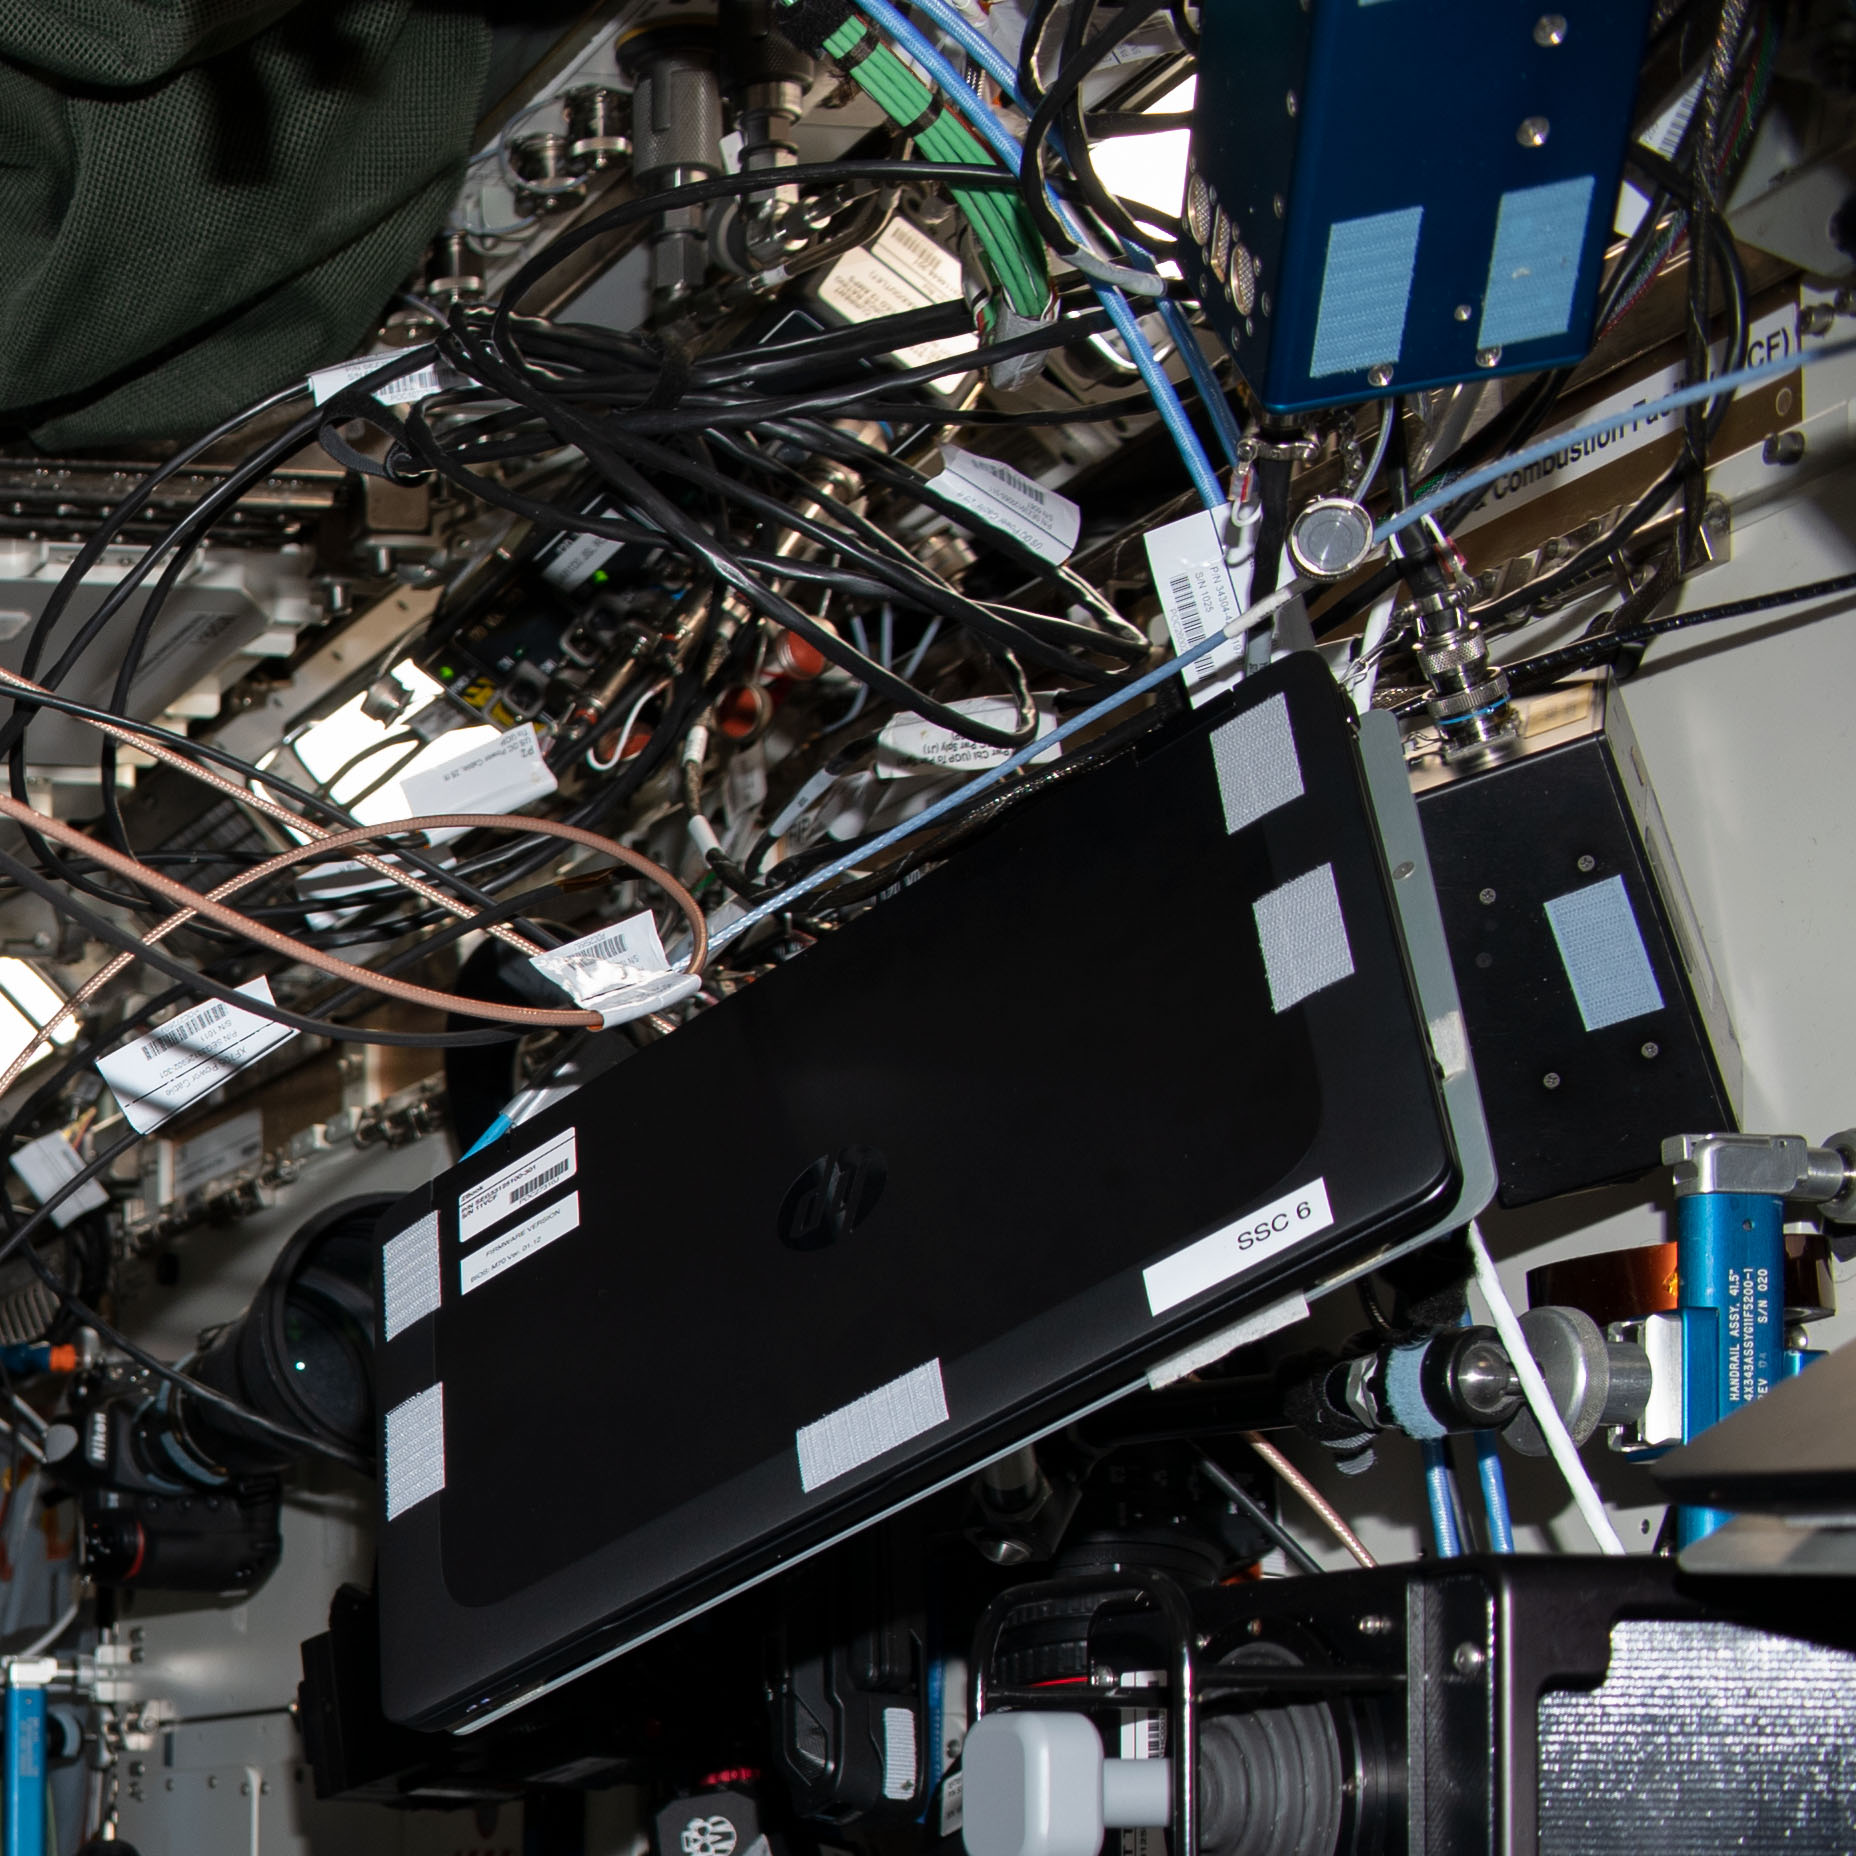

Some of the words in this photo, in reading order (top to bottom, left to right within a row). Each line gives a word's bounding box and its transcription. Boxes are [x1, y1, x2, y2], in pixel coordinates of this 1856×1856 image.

[998, 517, 1020, 535] Power
[1195, 571, 1206, 588] S/N
[1209, 565, 1222, 584] P/N
[1200, 591, 1213, 613] 1025
[484, 747, 507, 763] Power
[923, 744, 939, 754] (J1)
[940, 742, 958, 752] Sply
[991, 748, 1009, 756] Pwr
[217, 1018, 232, 1031] S/N
[222, 1029, 238, 1042] P/N
[217, 1045, 247, 1068] XF705
[190, 1062, 218, 1082] Power
[164, 1078, 190, 1098] Cable
[486, 1229, 523, 1256] FIRMWARE
[527, 1208, 559, 1232] VERSION
[1233, 1211, 1291, 1251] SSC
[1292, 1200, 1312, 1221] 6
[1729, 1268, 1739, 1295] 41.5"
[1758, 1269, 1767, 1290] 020
[1729, 1302, 1739, 1336] ASSY.
[1758, 1299, 1767, 1323] S/N
[1729, 1343, 1739, 1400] HANDRAIL
[1758, 1378, 1767, 1398] EV
[90, 1411, 109, 1461] Nikon
